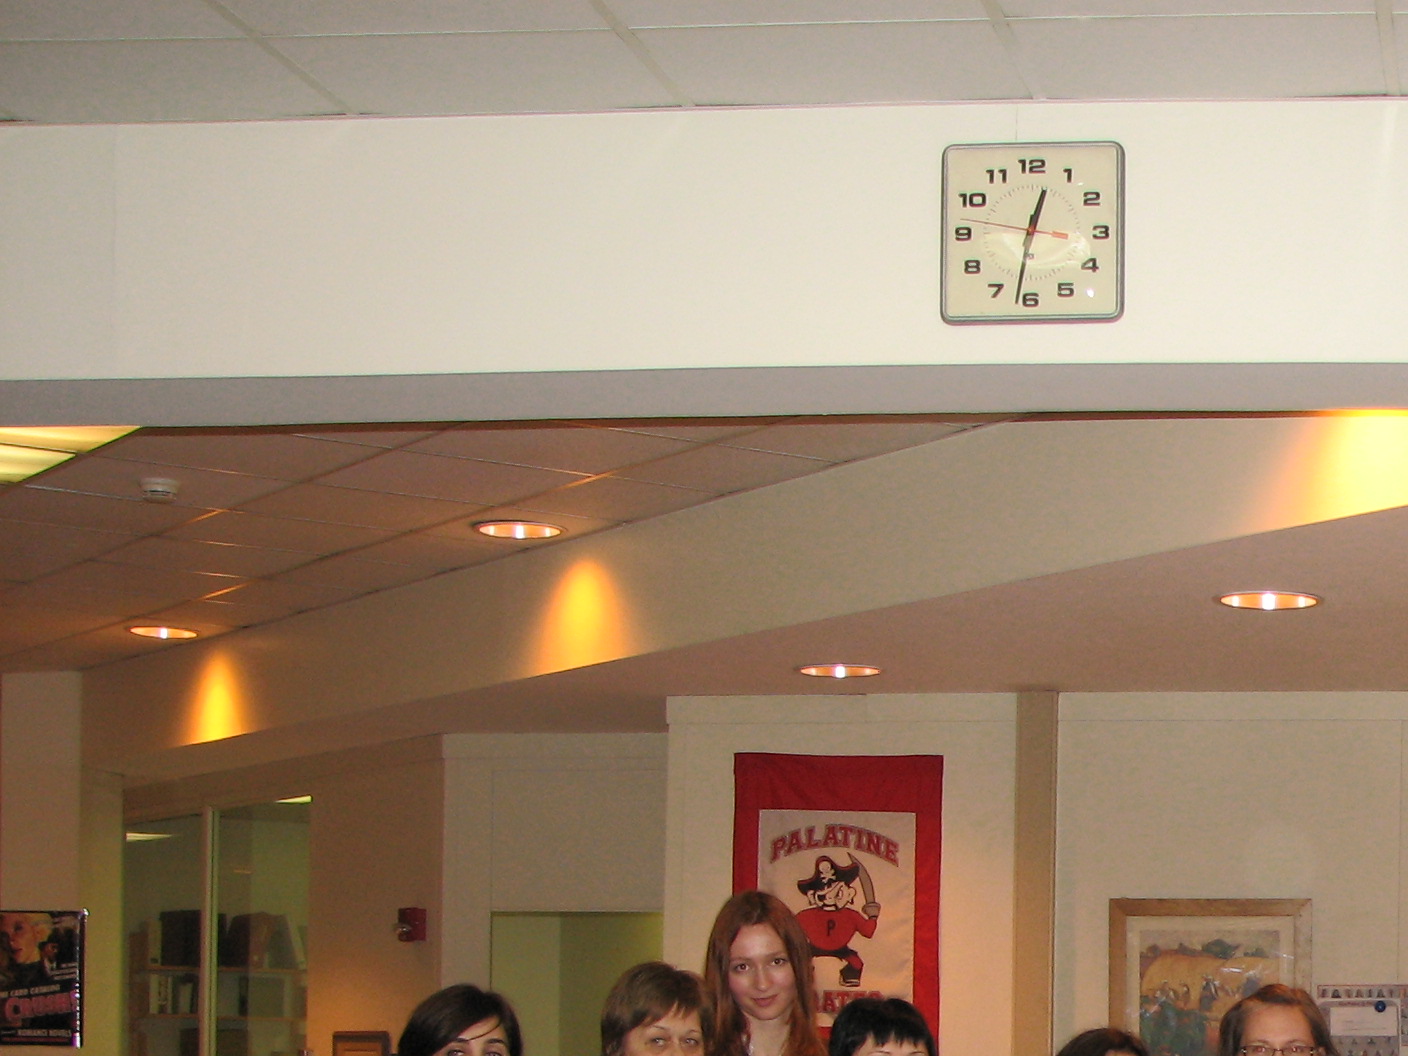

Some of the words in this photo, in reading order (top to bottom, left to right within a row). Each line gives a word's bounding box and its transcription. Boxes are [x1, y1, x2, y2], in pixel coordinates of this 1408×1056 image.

[1017, 158, 1046, 174] 12
[985, 168, 1008, 184] 11
[1063, 168, 1073, 183] 1
[958, 192, 987, 208] 10
[1083, 191, 1101, 206] 2
[954, 226, 972, 241] 9
[1092, 225, 1110, 240] 3
[964, 259, 981, 275] 8
[1081, 257, 1100, 273] 4
[987, 283, 1004, 299] 7
[1057, 282, 1075, 298] 5
[1022, 292, 1039, 308] 6
[770, 823, 899, 867] PALATINE
[825, 918, 836, 937] P
